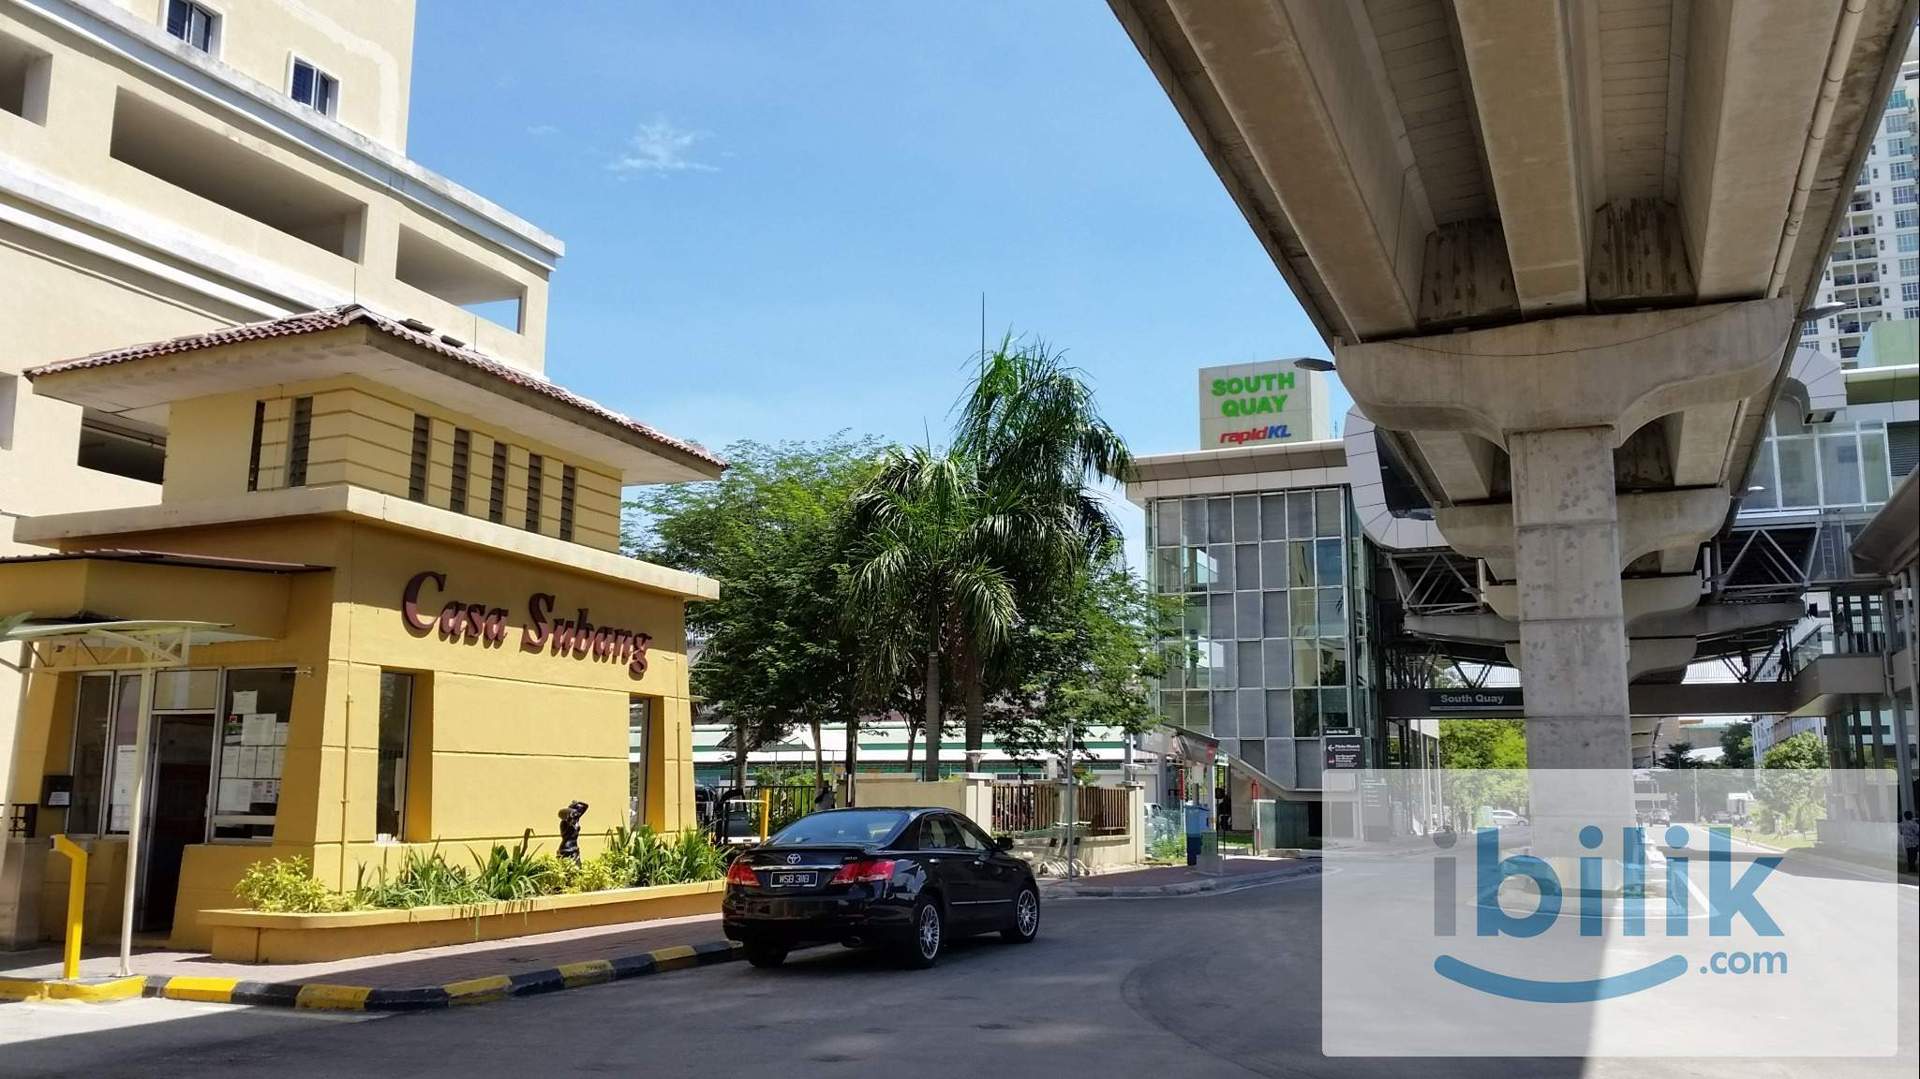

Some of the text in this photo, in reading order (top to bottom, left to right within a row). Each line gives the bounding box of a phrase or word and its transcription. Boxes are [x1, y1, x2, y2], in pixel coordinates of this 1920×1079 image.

[1211, 372, 1294, 396] SOUTH
[1221, 395, 1288, 417] QUAY
[1219, 425, 1292, 444] rapidKL
[402, 571, 652, 679] Casa Subang
[1440, 694, 1504, 704] South Quay
